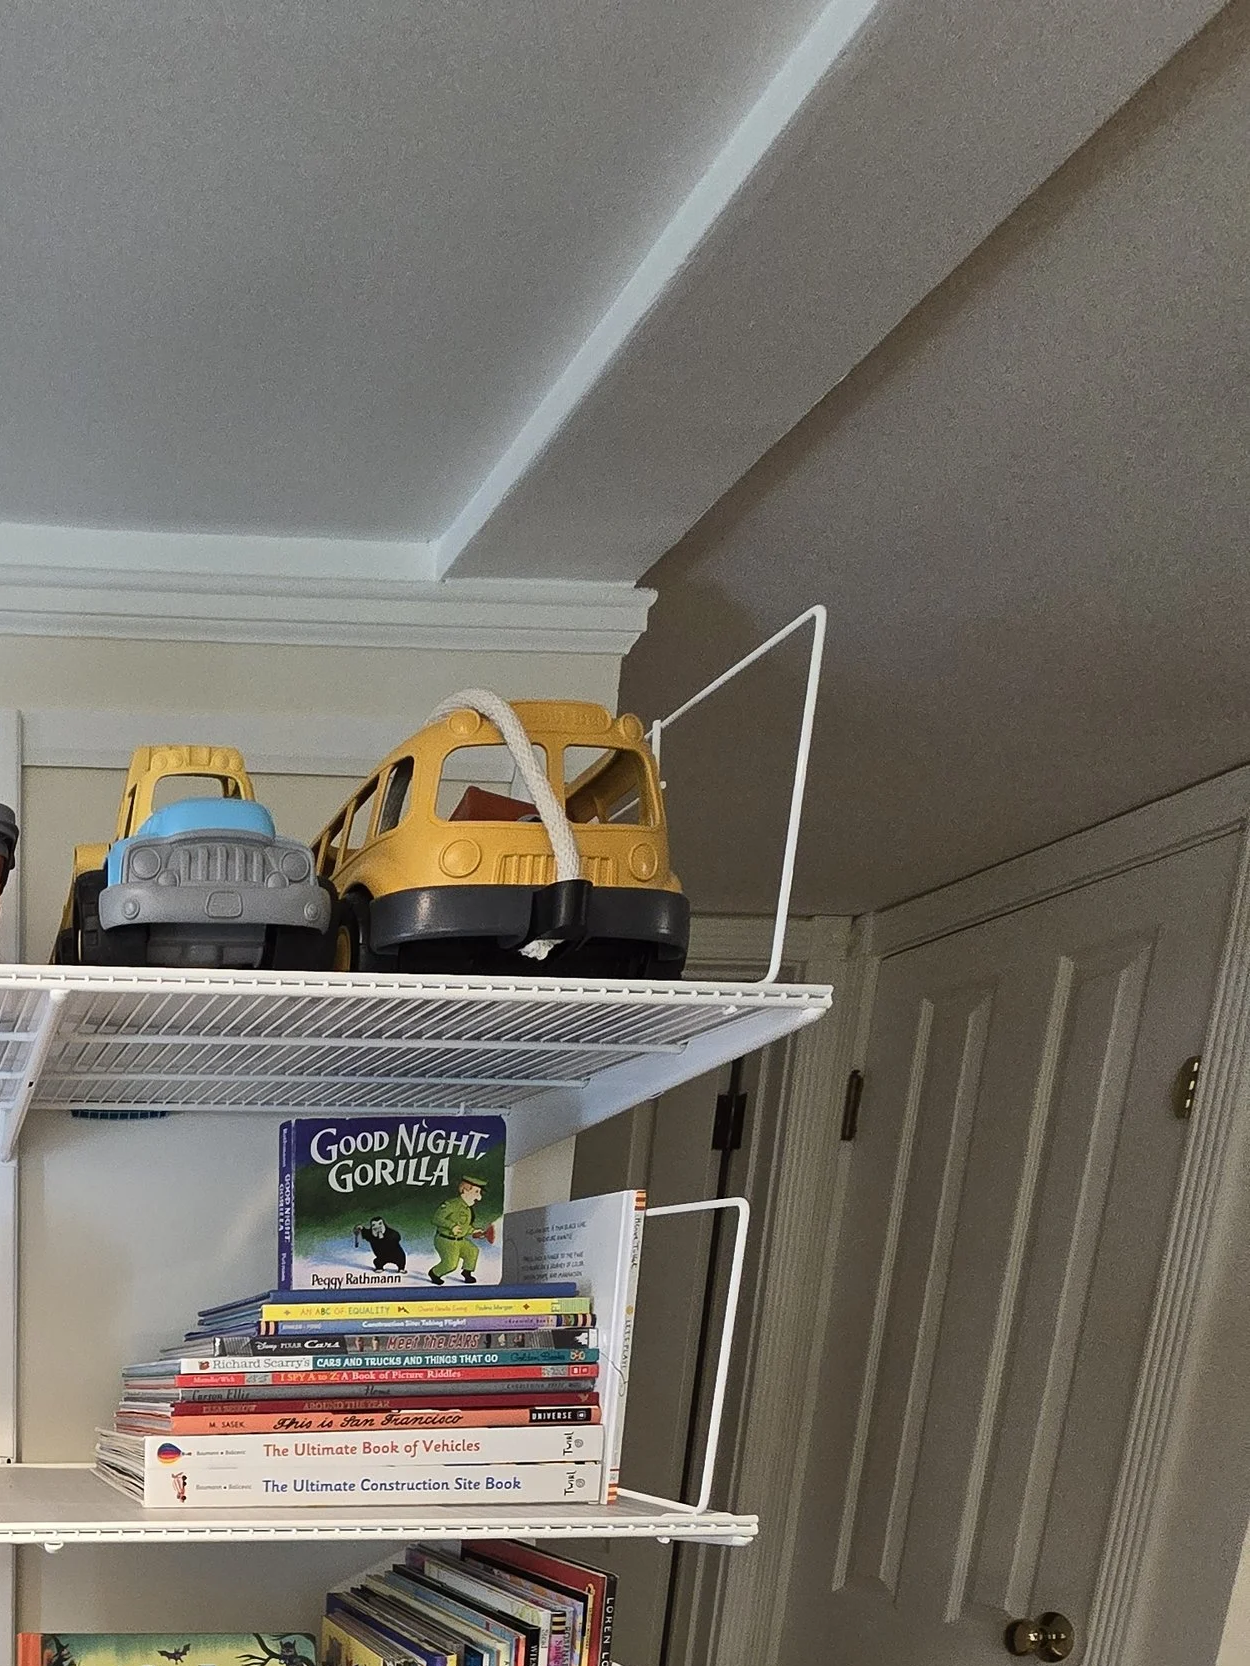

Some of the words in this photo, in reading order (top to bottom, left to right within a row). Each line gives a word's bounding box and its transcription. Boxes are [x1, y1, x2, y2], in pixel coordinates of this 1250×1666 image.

[310, 1127, 390, 1165] GOOD
[328, 1155, 450, 1193] GORILLA
[312, 1274, 343, 1290] Peggy
[346, 1272, 401, 1285] Rathmann
[213, 1357, 261, 1370] Richard
[263, 1356, 310, 1371] Scarry's
[317, 1357, 341, 1367] CARS
[344, 1357, 363, 1367] AND
[365, 1356, 401, 1366] TRUCKS
[403, 1355, 422, 1365] AND
[424, 1355, 459, 1365] THINGS
[461, 1354, 483, 1363] THAT
[485, 1354, 498, 1363] GO
[273, 1417, 312, 1430] This
[318, 1417, 333, 1428] is
[340, 1415, 375, 1427] San
[381, 1413, 463, 1426] Francisco
[532, 1412, 572, 1420] UNIVERSE
[264, 1444, 289, 1457] The
[294, 1442, 357, 1456] Ultimate
[362, 1441, 399, 1454] Book
[404, 1440, 419, 1457] of
[422, 1440, 480, 1452] Vehicles
[263, 1480, 288, 1492] The
[294, 1479, 356, 1492] Ultimate
[361, 1477, 450, 1491] Construction
[454, 1477, 481, 1490] Site
[485, 1476, 521, 1490] Book
[604, 1597, 615, 1644] LOREN
